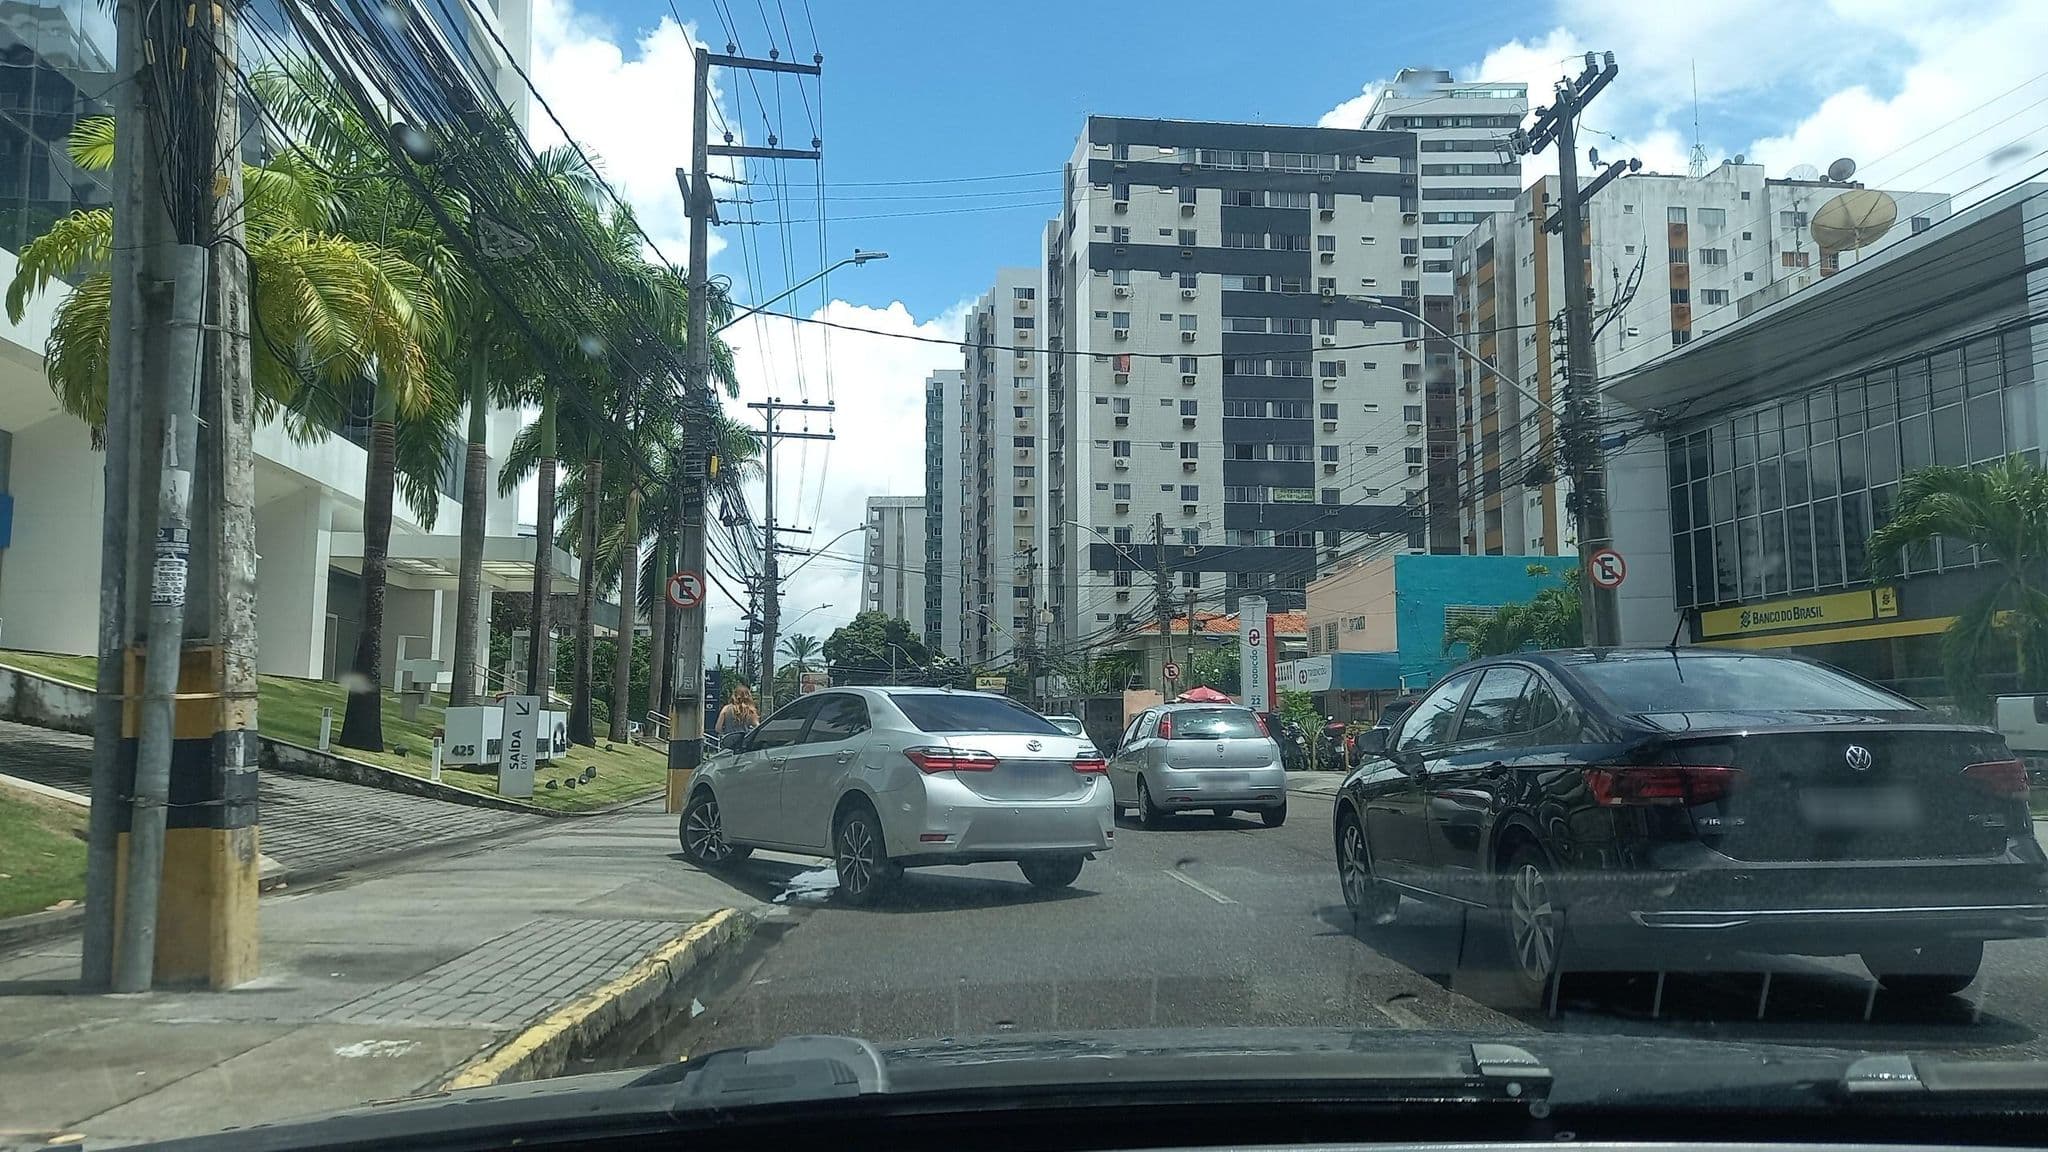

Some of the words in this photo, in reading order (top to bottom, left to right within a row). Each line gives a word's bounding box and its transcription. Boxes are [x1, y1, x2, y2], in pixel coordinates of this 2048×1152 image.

[1752, 612, 1780, 625] BANCO
[1793, 606, 1824, 620] BRASIL
[452, 745, 475, 756] 425
[508, 729, 522, 770] SAÍDA
[520, 754, 529, 770] EXIT
